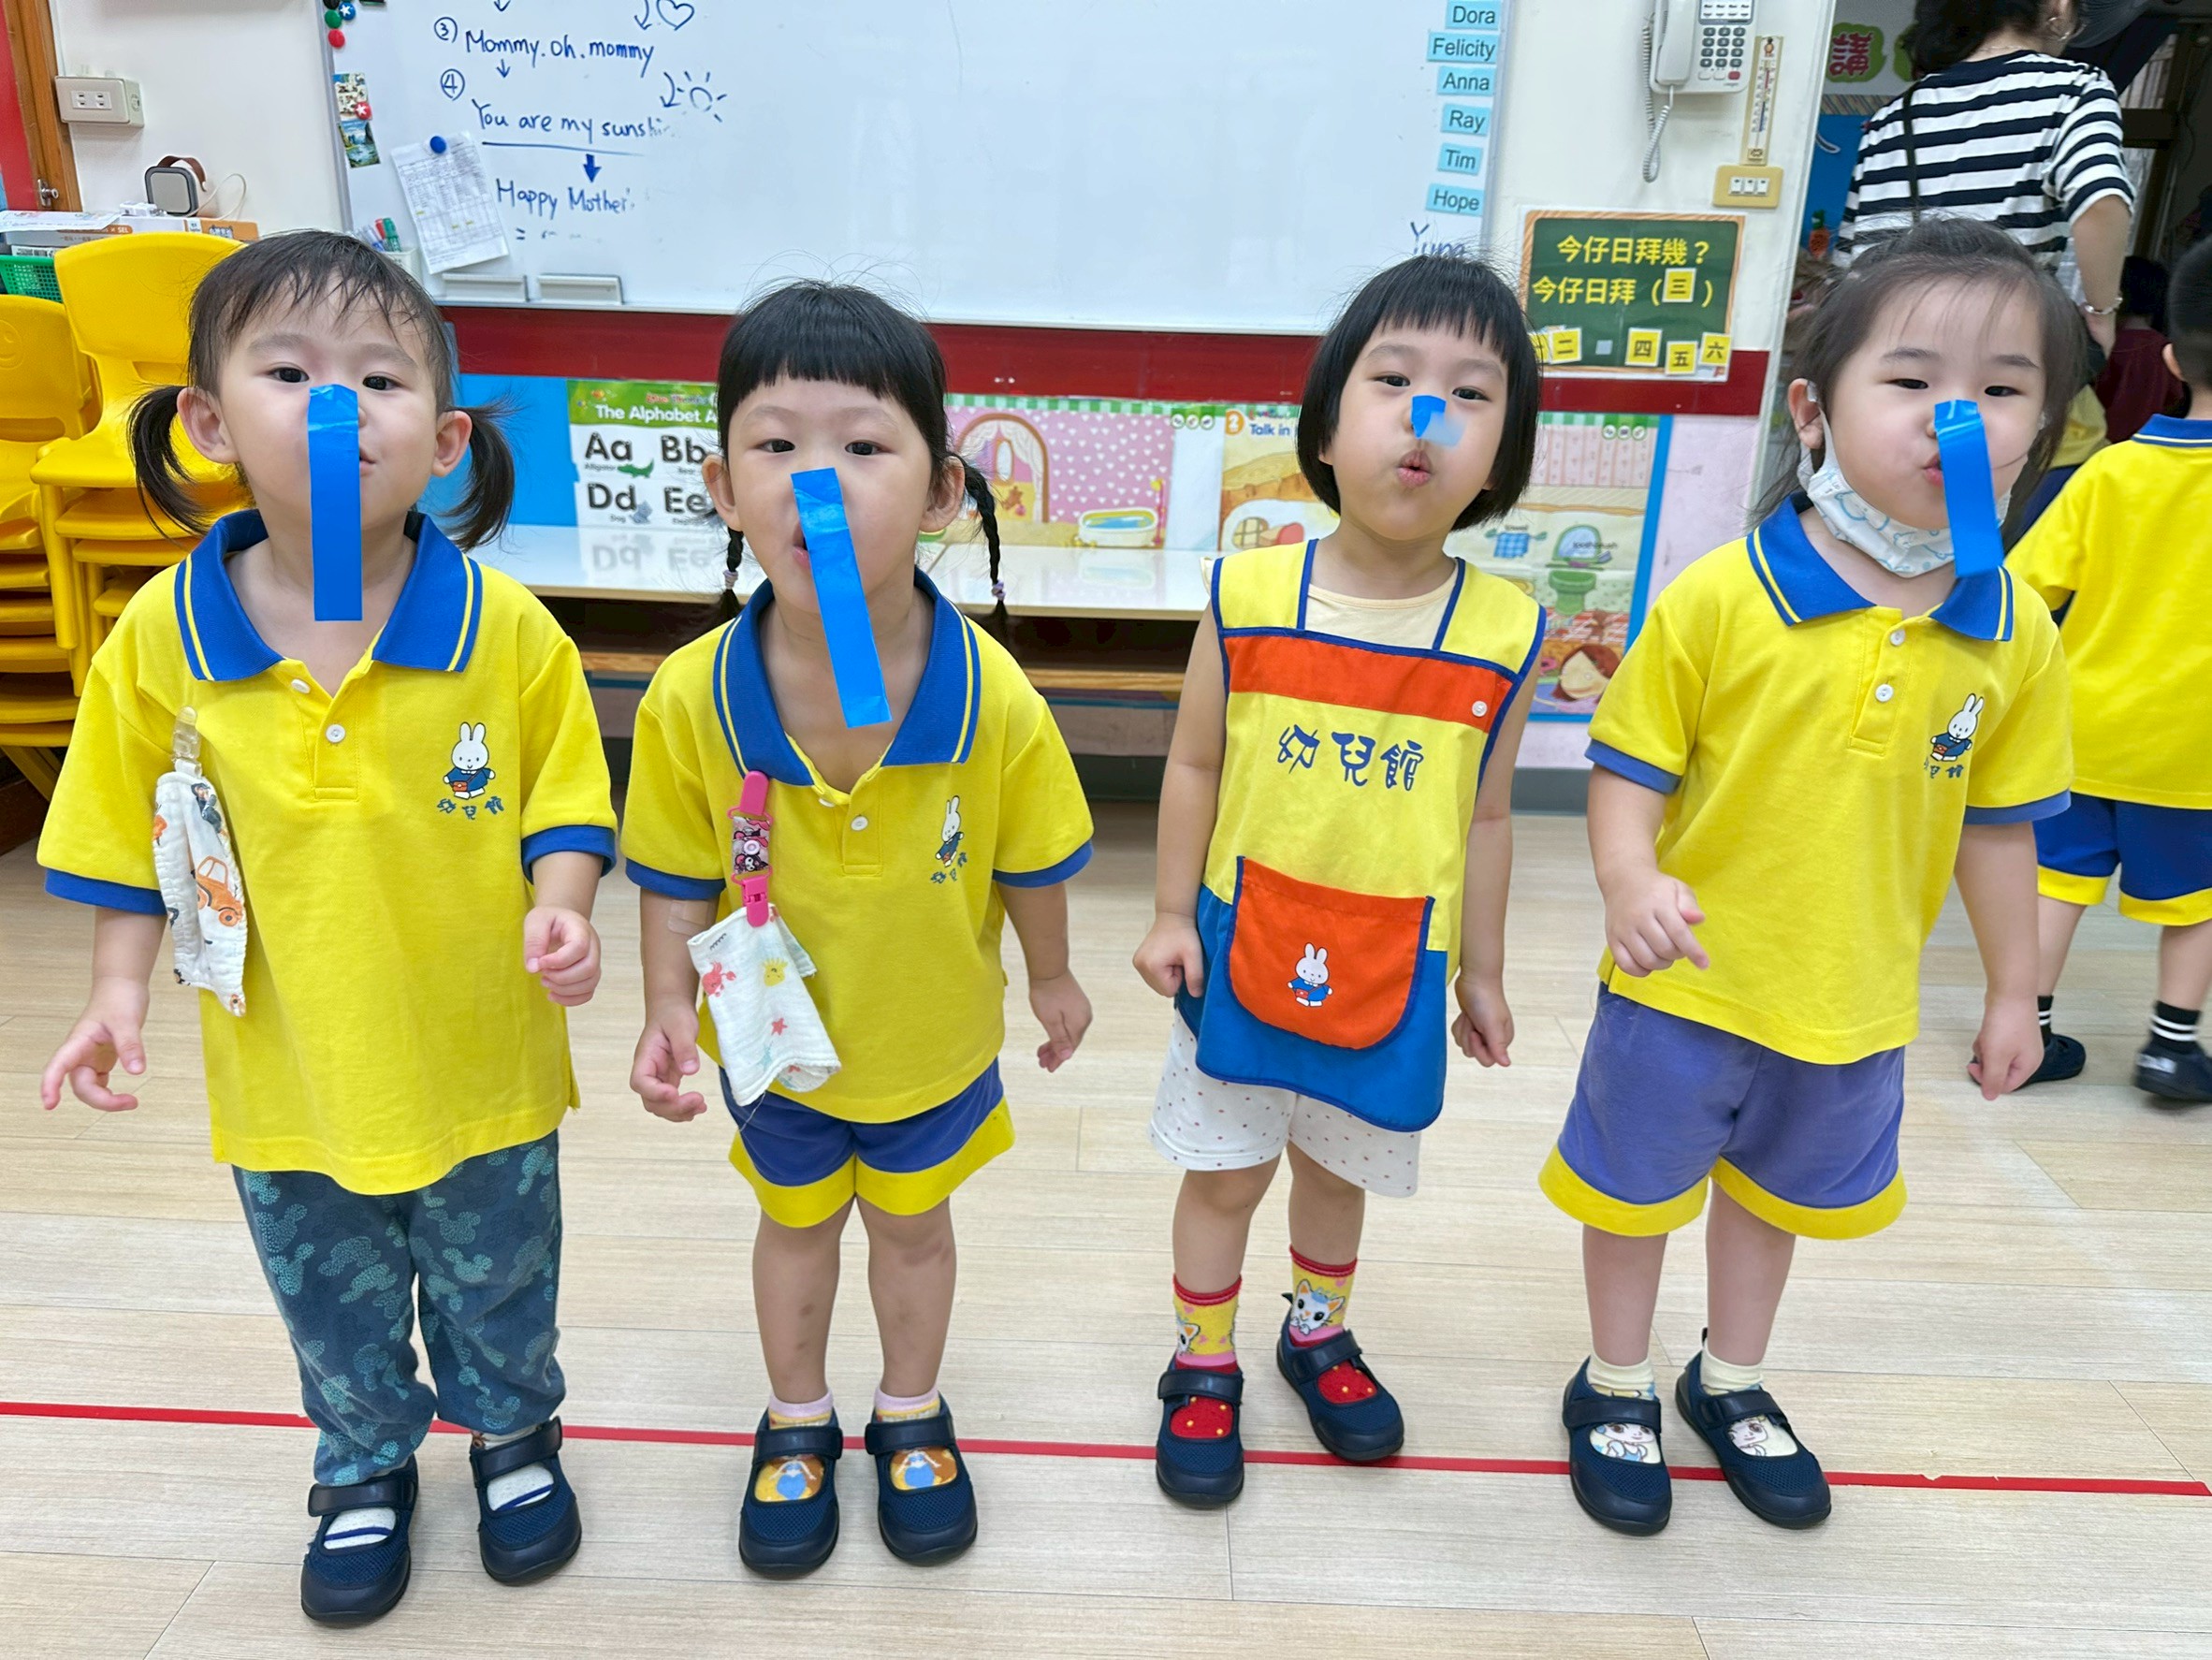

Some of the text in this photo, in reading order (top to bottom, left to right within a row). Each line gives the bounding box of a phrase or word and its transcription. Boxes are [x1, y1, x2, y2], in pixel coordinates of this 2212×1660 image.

[1452, 6, 1496, 24] Dora
[1432, 37, 1496, 62] Felicity
[1442, 73, 1490, 91] Anna
[471, 98, 509, 130] You
[518, 115, 552, 132] are
[561, 117, 593, 144] my
[1448, 110, 1485, 133] Ray
[1446, 150, 1477, 169] Tim
[496, 178, 558, 220] Happy
[1433, 189, 1480, 212] Hope
[1634, 340, 1652, 357] 四
[1673, 350, 1689, 367] 五
[1706, 341, 1725, 359] 六
[595, 404, 626, 420] The
[629, 404, 702, 424] Alphabet
[1250, 423, 1290, 436] Talk in
[585, 431, 706, 464] Aa Bb
[588, 482, 708, 514] Dd Ee
[1277, 724, 1425, 792] 幼兒館
